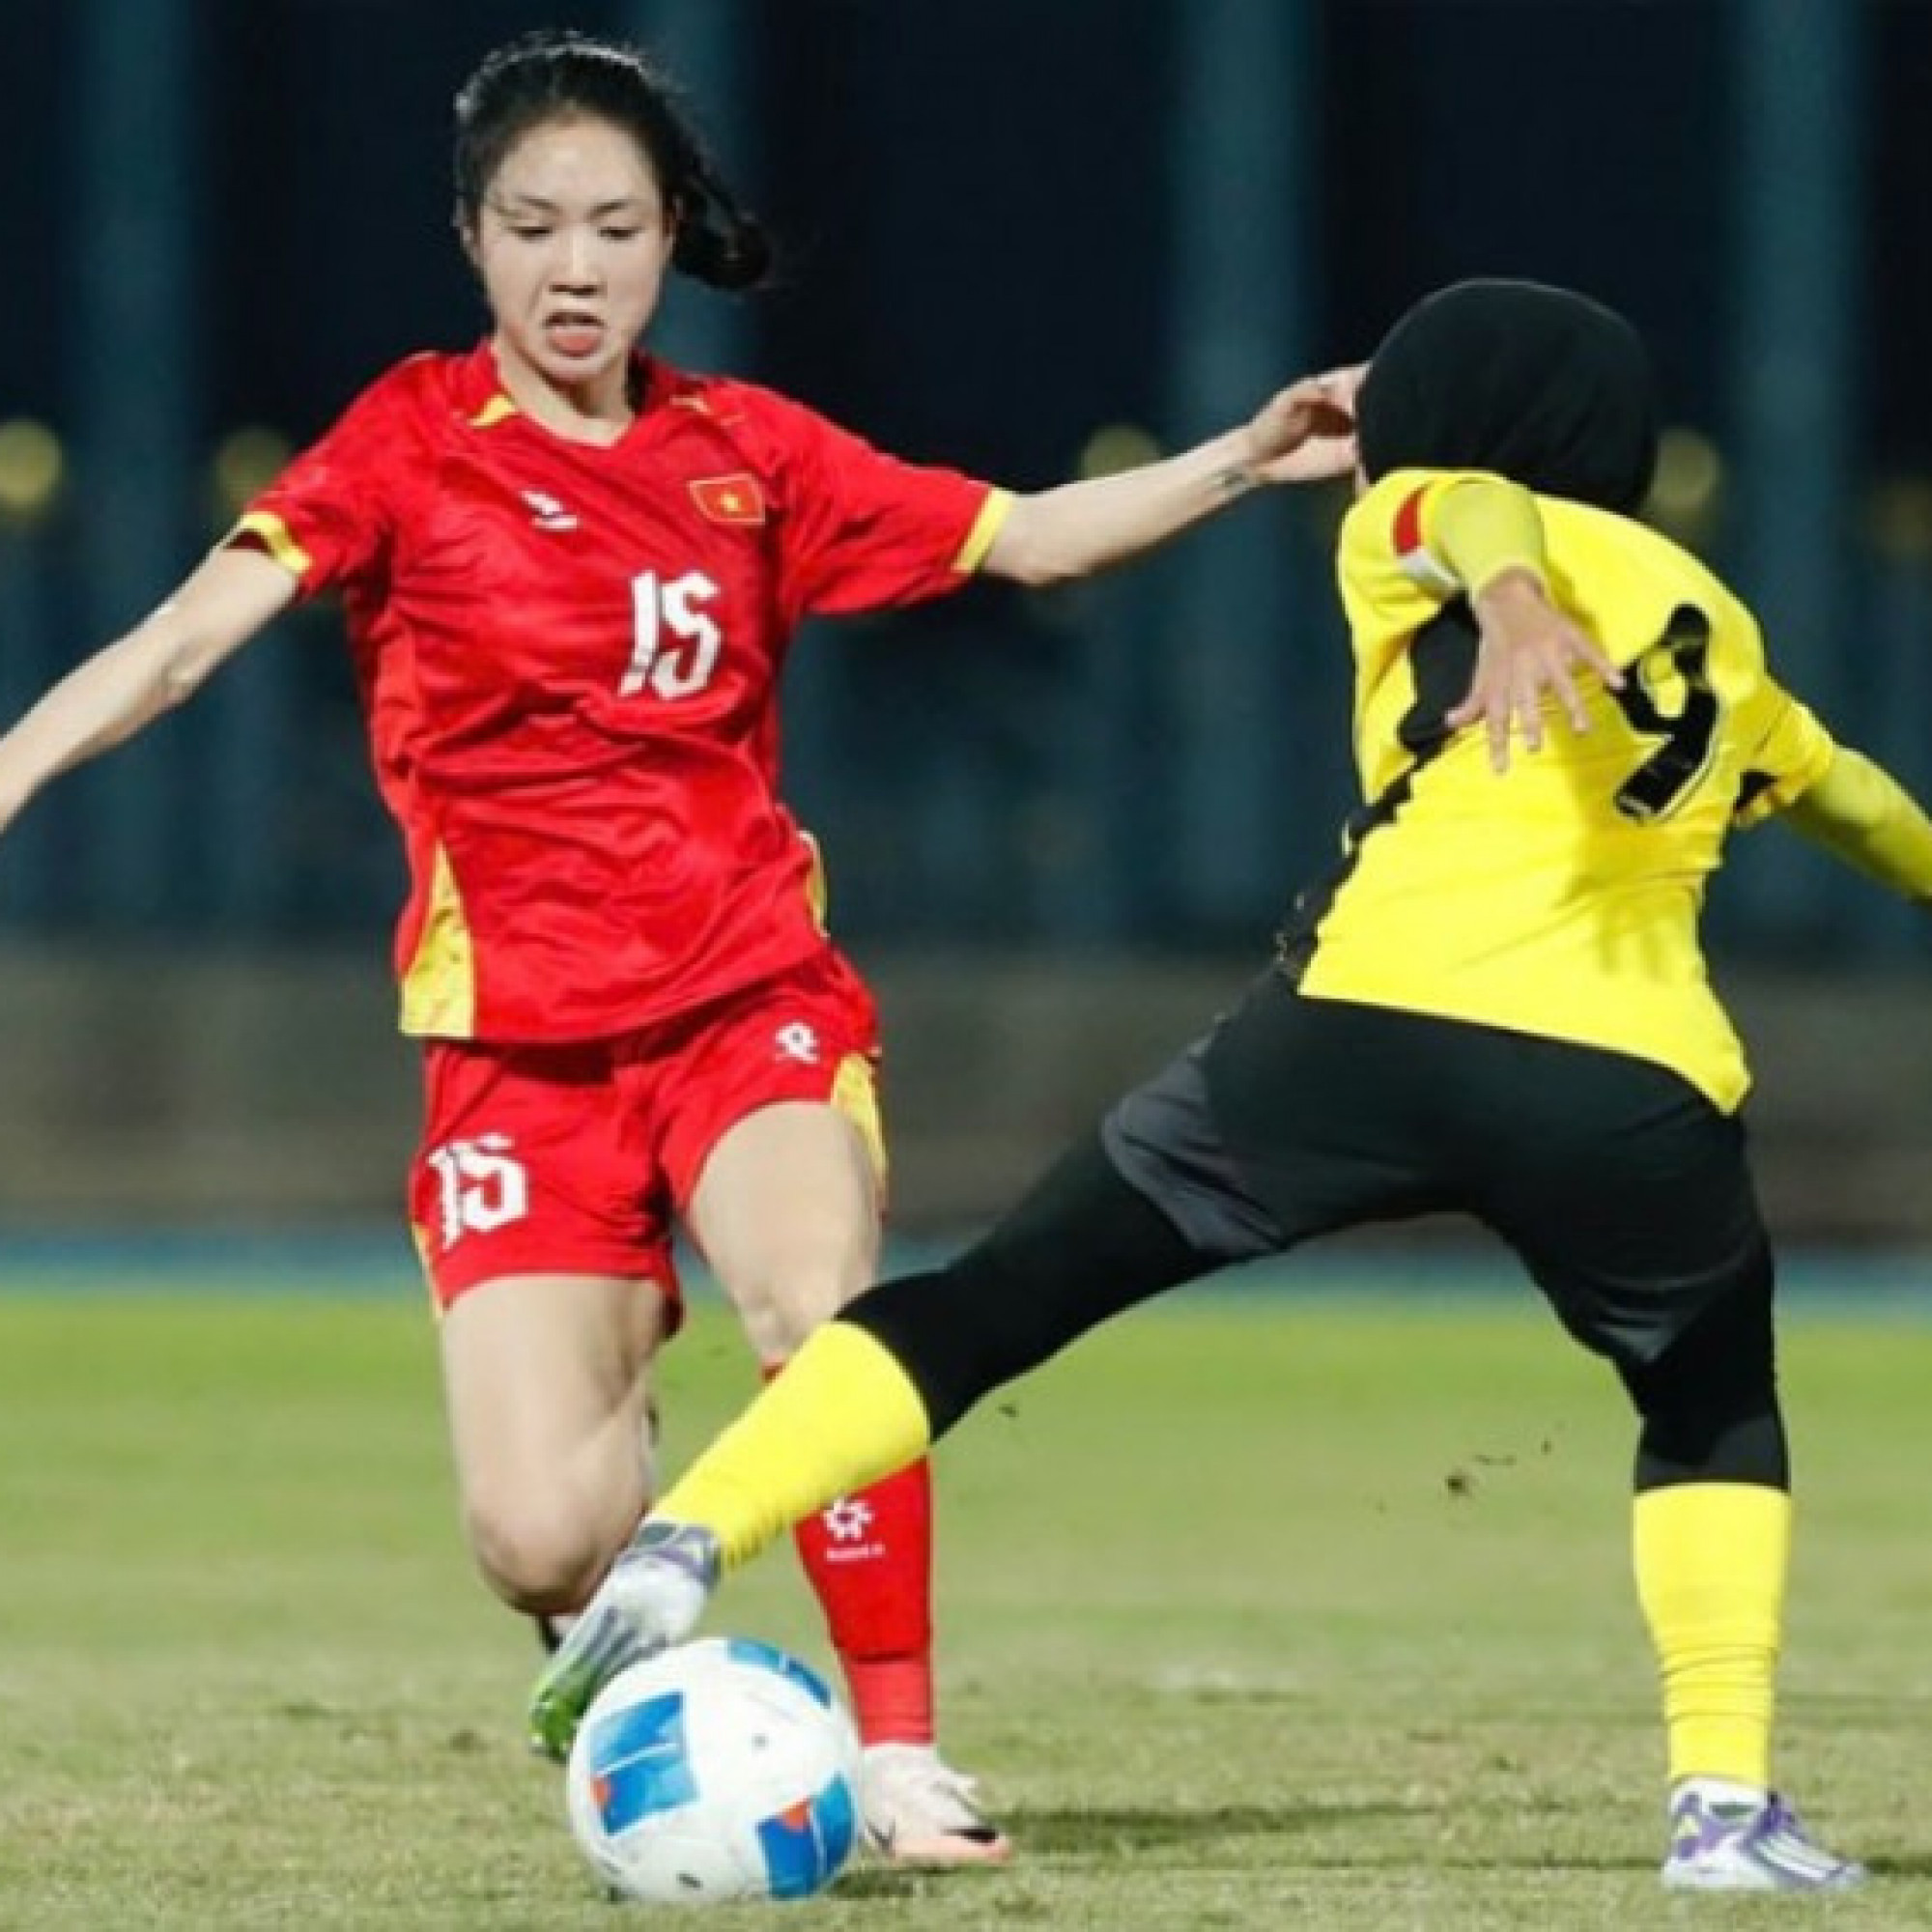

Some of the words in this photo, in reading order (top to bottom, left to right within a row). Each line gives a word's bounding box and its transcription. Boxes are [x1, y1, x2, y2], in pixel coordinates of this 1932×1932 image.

[617, 568, 721, 699] 15
[1606, 602, 1719, 821] 9
[428, 1132, 528, 1251] 15
